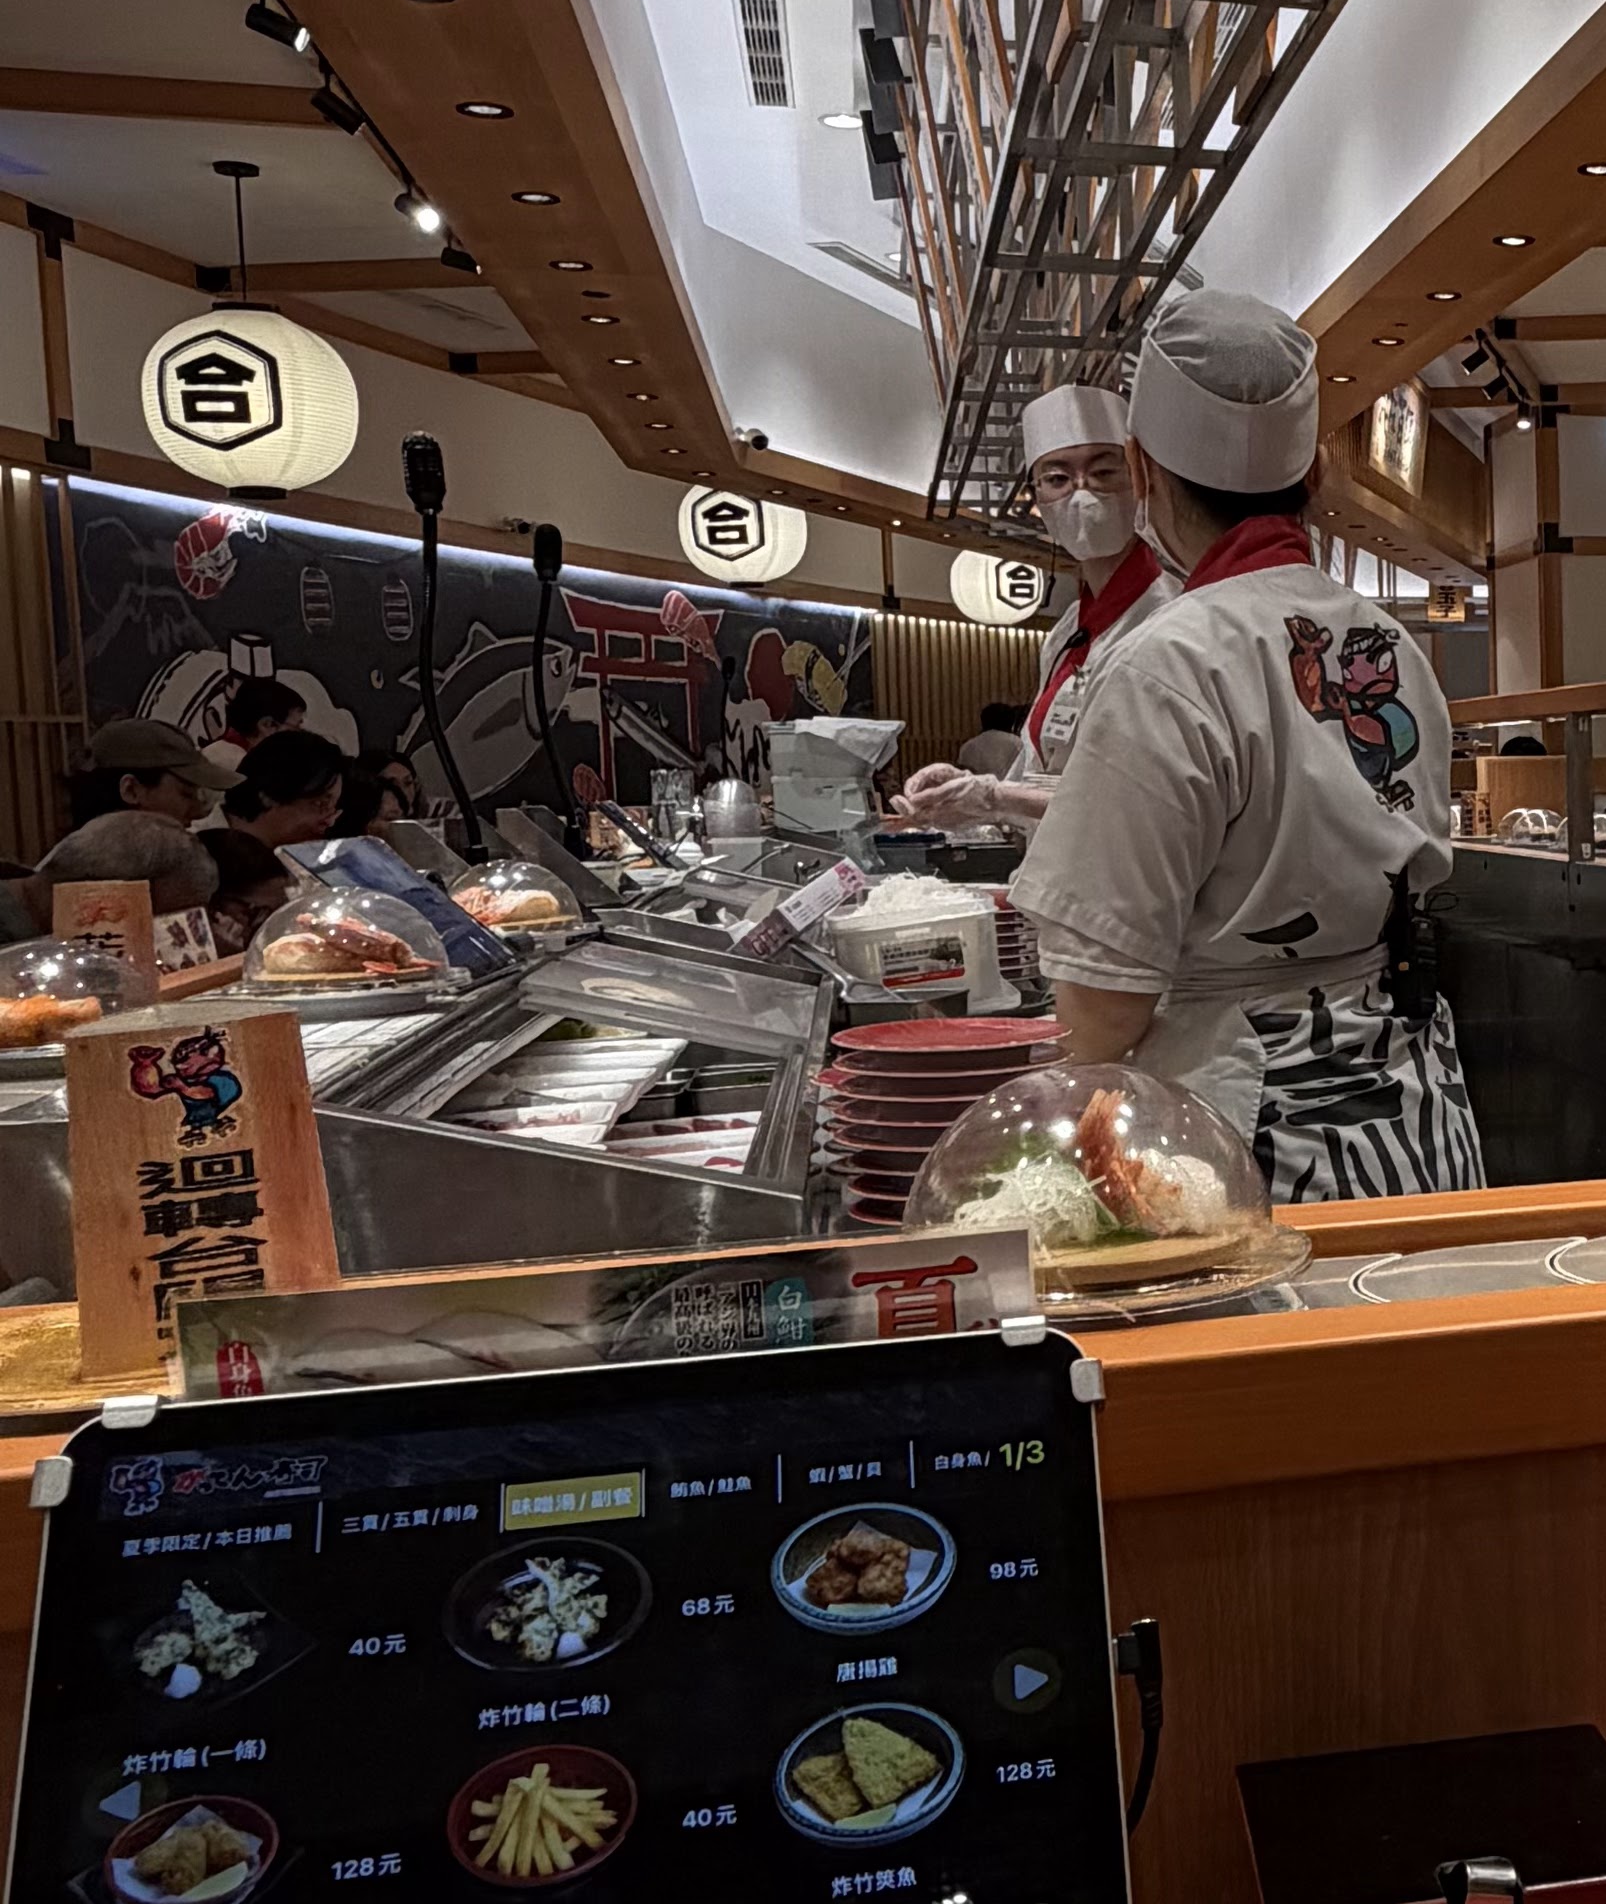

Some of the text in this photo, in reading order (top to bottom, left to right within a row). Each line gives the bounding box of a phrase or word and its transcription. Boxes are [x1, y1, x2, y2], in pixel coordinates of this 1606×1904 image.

[998, 1441, 1046, 1471] 1/3
[990, 1559, 1039, 1580] 98元
[681, 1595, 735, 1618] 68元
[348, 1633, 407, 1657] 40元
[996, 1758, 1057, 1784] 128元
[682, 1805, 738, 1829] 40元
[331, 1853, 401, 1882] 128元
